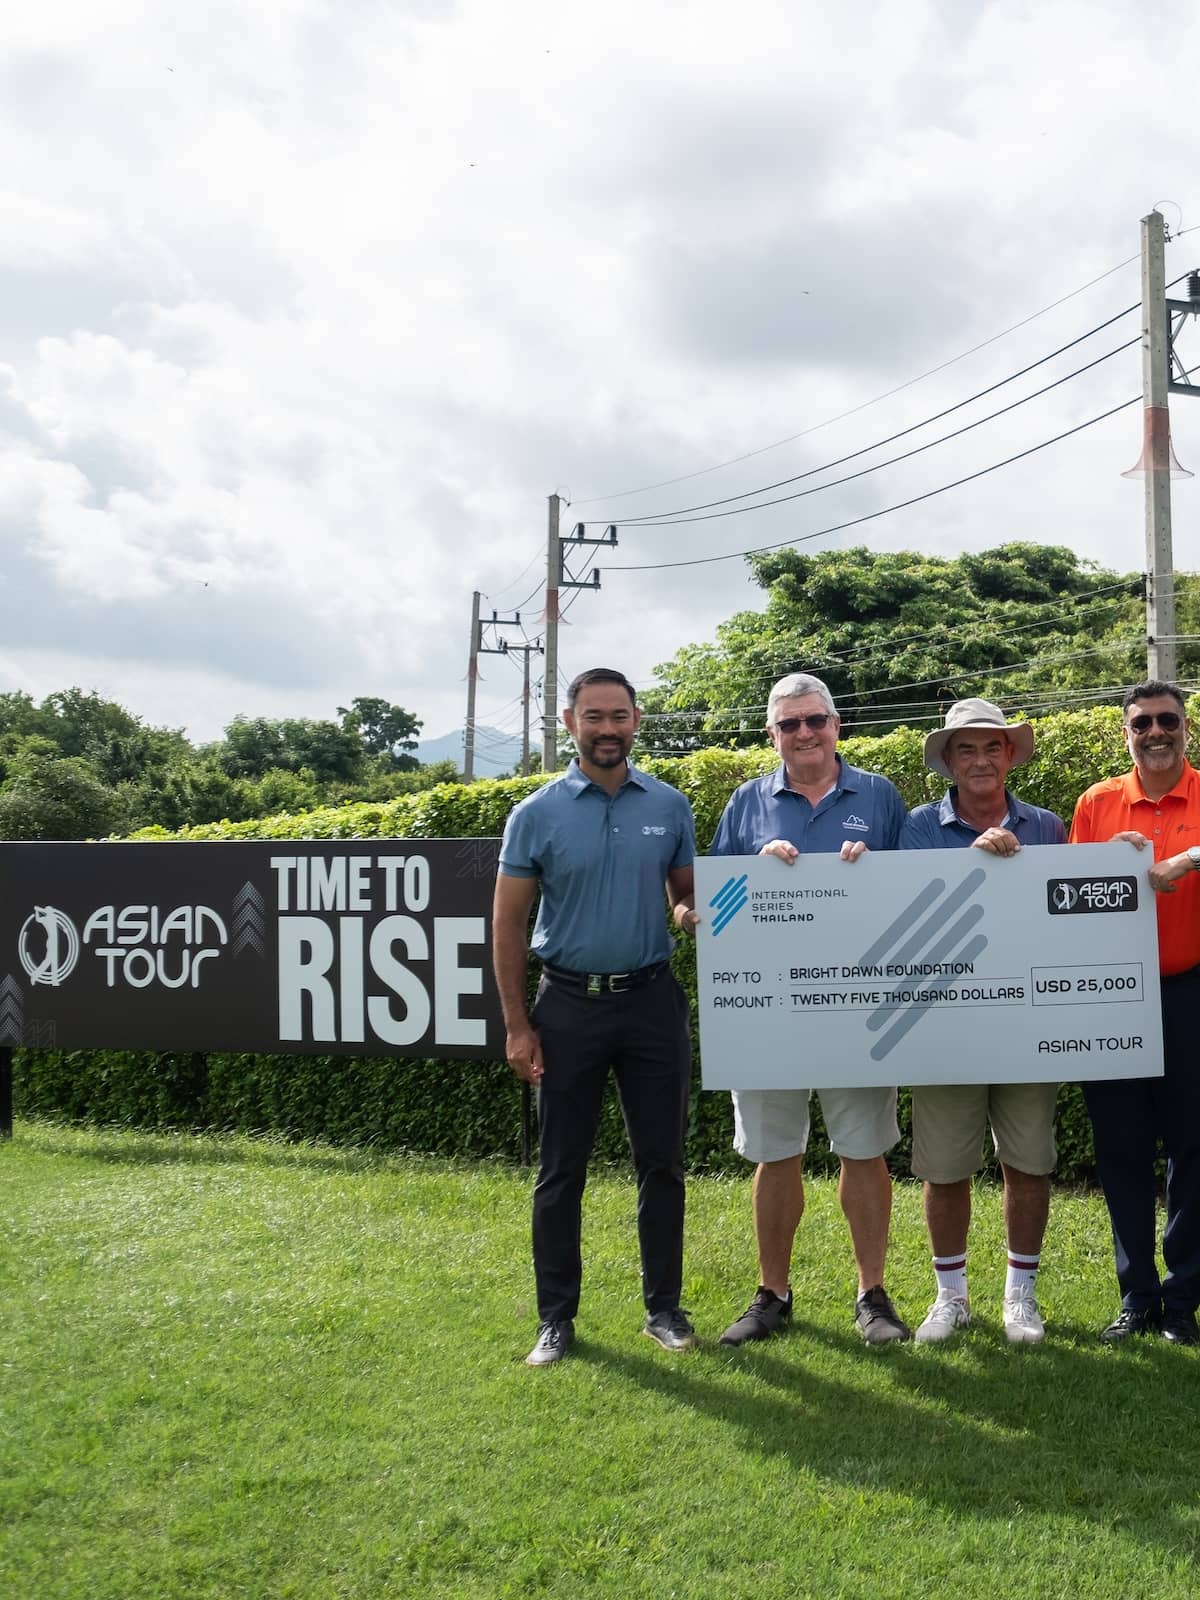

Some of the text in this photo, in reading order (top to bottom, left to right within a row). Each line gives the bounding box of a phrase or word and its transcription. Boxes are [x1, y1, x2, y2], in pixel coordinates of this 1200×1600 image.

[270, 855, 430, 912] TIME TO
[1079, 882, 1132, 896] ASIAN
[751, 889, 848, 900] INTERNATIONAL
[1084, 894, 1130, 908] TOUR
[751, 902, 794, 912] SERIES
[83, 905, 228, 945] ASIAN
[752, 913, 814, 923] THAILAND
[95, 948, 220, 989] TOUR
[713, 972, 739, 984] PAY
[742, 971, 761, 984] TO
[790, 967, 838, 979] BRIGHT
[842, 965, 883, 978] DAWN
[886, 963, 974, 977] FOUNDATION
[278, 916, 487, 1046] RISE
[1036, 977, 1136, 993] USD 25,000
[713, 996, 773, 1008] AMOUNT
[791, 993, 848, 1006] TWENTY
[851, 992, 880, 1004] FIVE
[884, 990, 958, 1003] THOUSAND
[961, 987, 1025, 1000] DOLLARS
[1038, 1037, 1143, 1053] ASIAN TOUR
